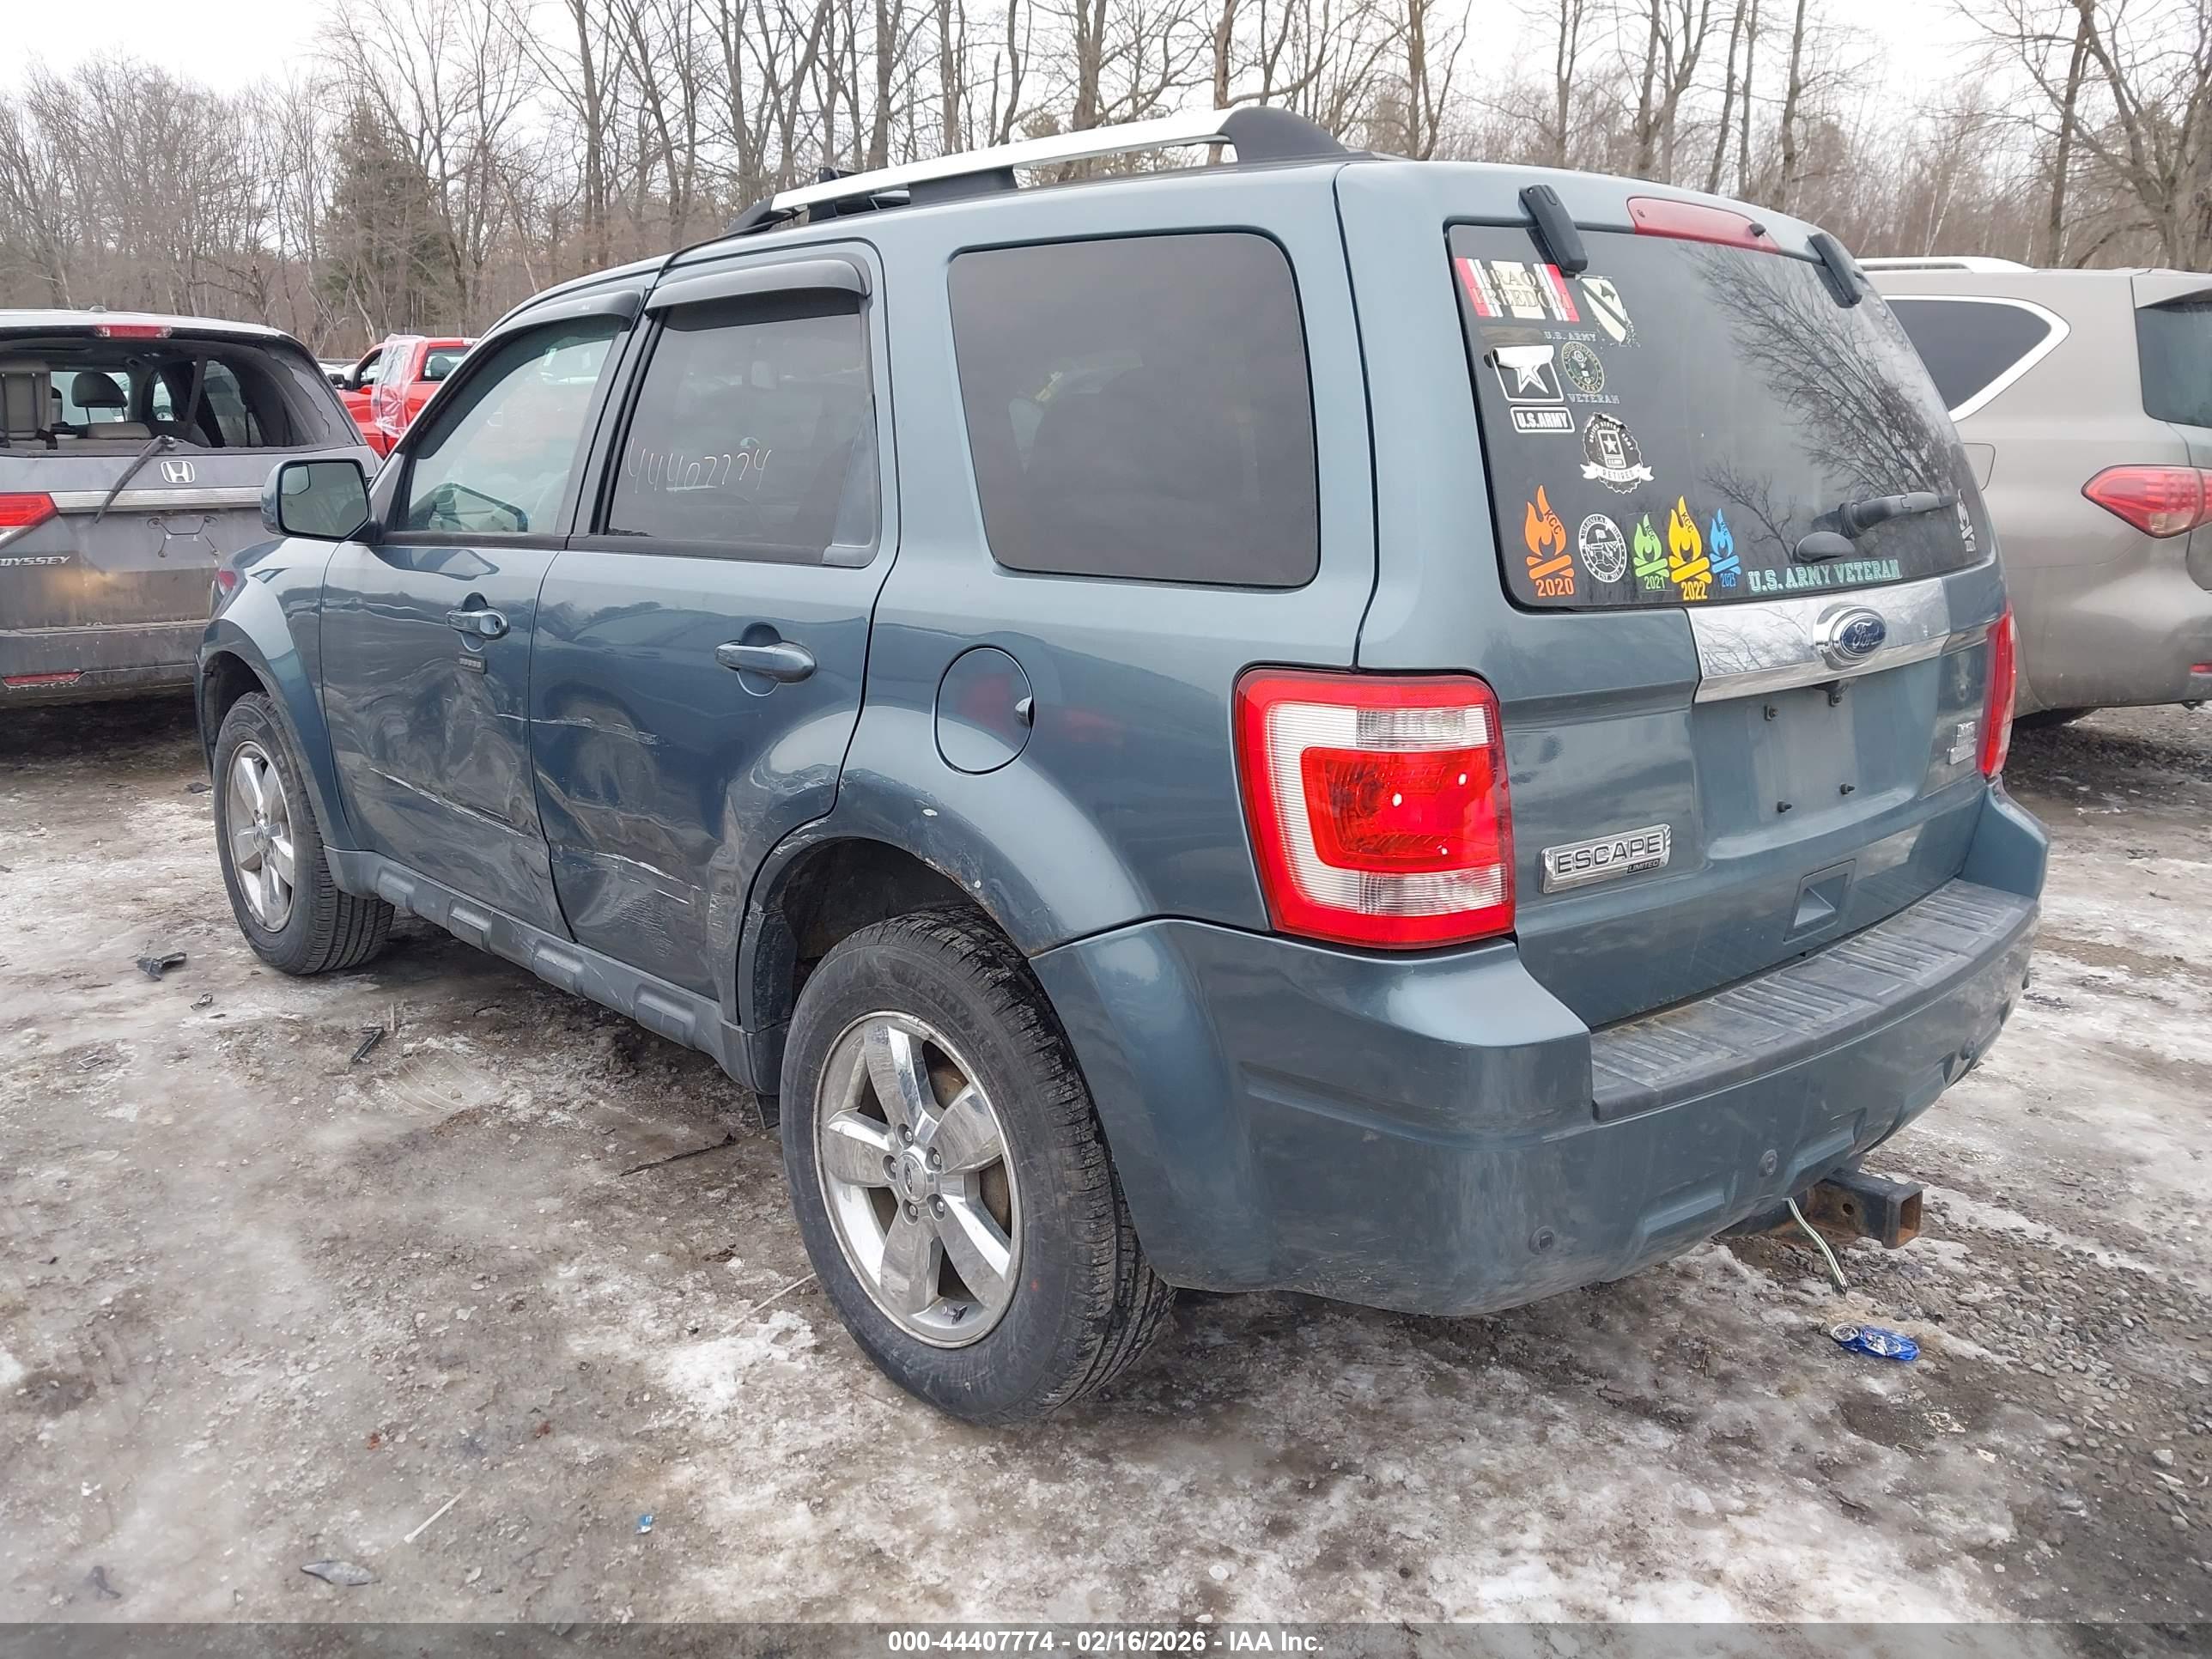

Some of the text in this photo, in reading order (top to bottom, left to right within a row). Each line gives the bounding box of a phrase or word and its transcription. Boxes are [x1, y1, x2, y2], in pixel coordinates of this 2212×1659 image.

[1482, 269, 1538, 289] IRAQ
[1568, 332, 1596, 342] ARMY
[1567, 393, 1620, 404] VETERAN
[1545, 510, 1562, 535] KCC
[1680, 512, 1694, 533] KCC
[1644, 576, 1665, 590] 2021
[1748, 559, 1900, 592] U.S. ARMY VETERAN
[1536, 579, 1574, 597] 2020
[1681, 580, 1708, 600] 2022
[1557, 834, 1661, 873] ESCAPE
[1628, 860, 1660, 872] LIMITED
